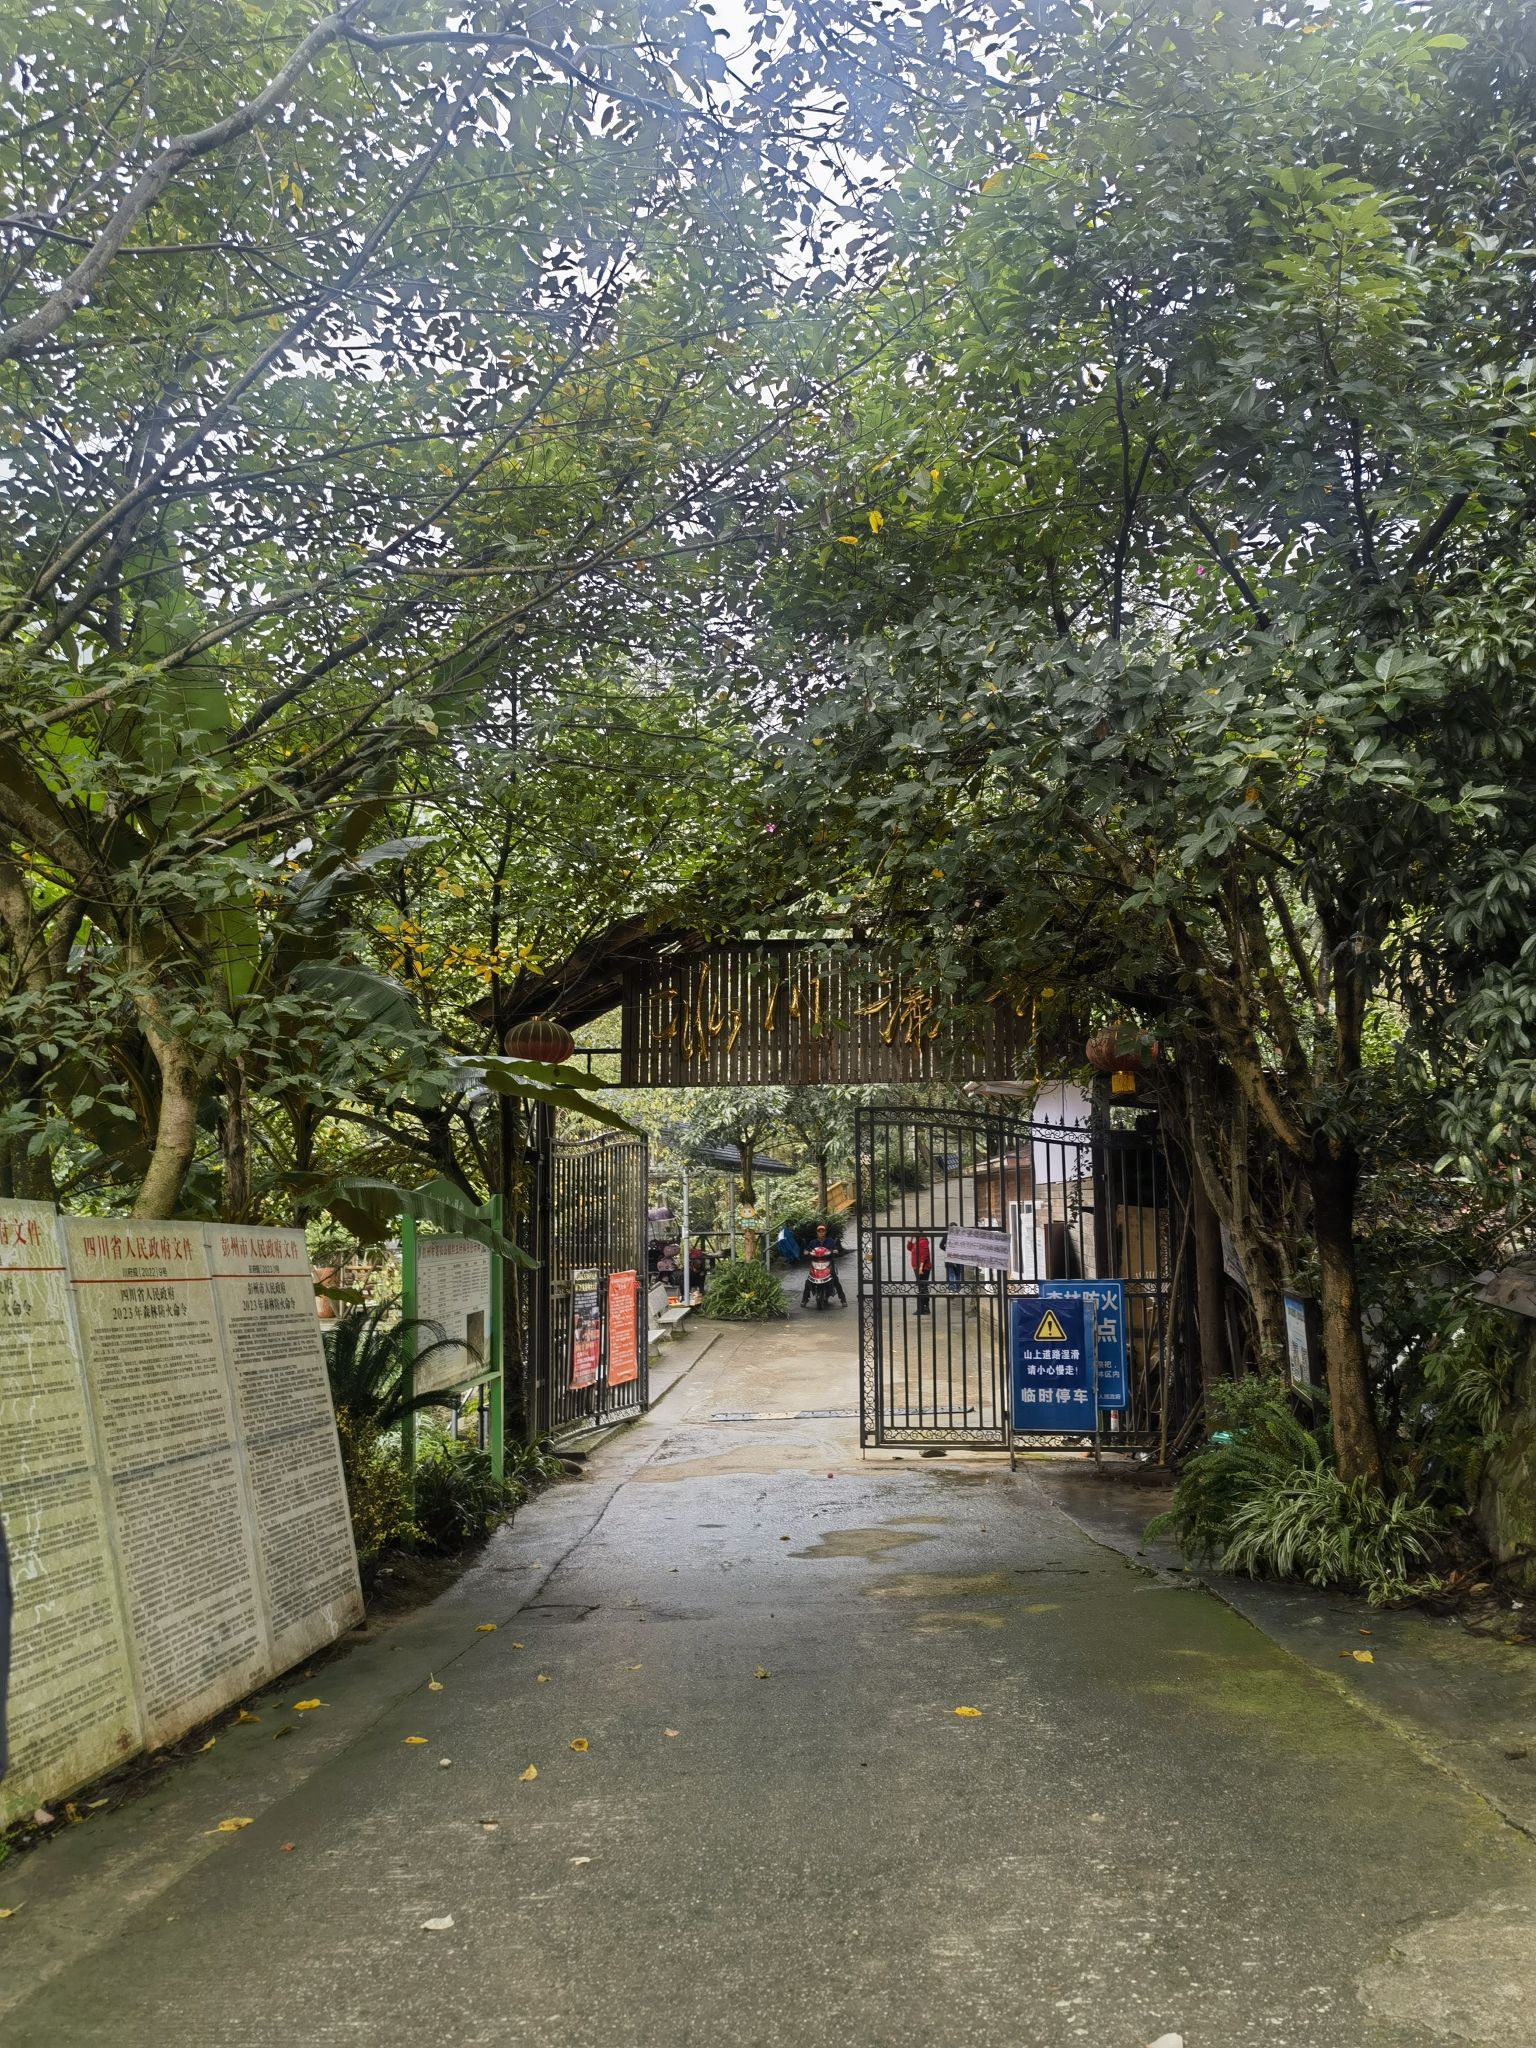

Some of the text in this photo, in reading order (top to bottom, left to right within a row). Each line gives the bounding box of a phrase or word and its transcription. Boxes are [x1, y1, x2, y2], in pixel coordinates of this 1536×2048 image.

[83, 1235, 193, 1260] 四川省人民政府文件
[221, 1236, 299, 1259] 彭州市人民政府文件
[120, 1286, 175, 1302] 四川省人民政府
[247, 1281, 286, 1295] 彭州市人民政府
[112, 1302, 188, 1320] 2023年森林防火命令
[242, 1297, 296, 1311] 2023年森林防火命令
[1098, 1318, 1118, 1343] 点
[1023, 1349, 1080, 1360] 山上道路湿滑
[1021, 1388, 1088, 1404] 临时停车
